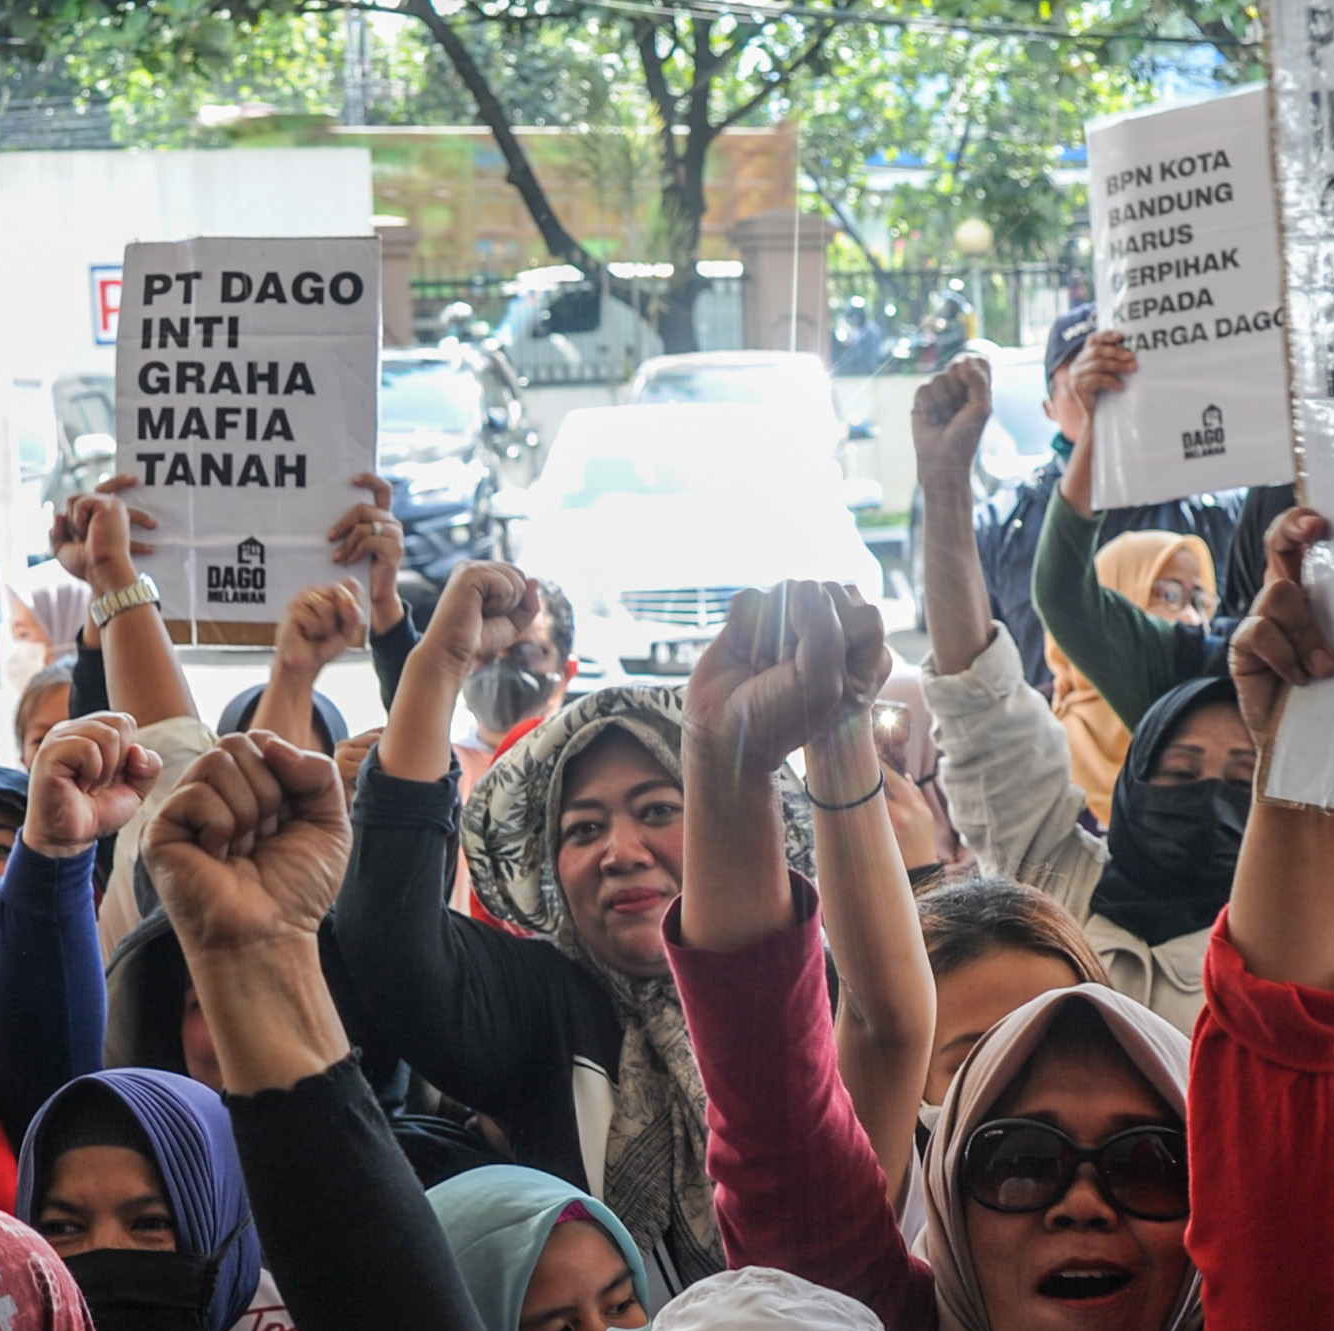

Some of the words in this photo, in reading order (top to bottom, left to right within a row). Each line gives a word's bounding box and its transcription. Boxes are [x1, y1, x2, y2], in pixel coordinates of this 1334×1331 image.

[1106, 165, 1153, 197] BPN
[1159, 149, 1231, 182] KOTA
[1108, 182, 1234, 230] BANDUNG
[142, 271, 203, 306] PT
[220, 271, 364, 305] DAGO
[140, 315, 240, 350] INTI
[1120, 322, 1209, 352] ARGA
[137, 361, 316, 396] GRAHA
[136, 407, 295, 441] MAFIA
[136, 453, 307, 488] TANAH
[207, 565, 266, 590] DAGO
